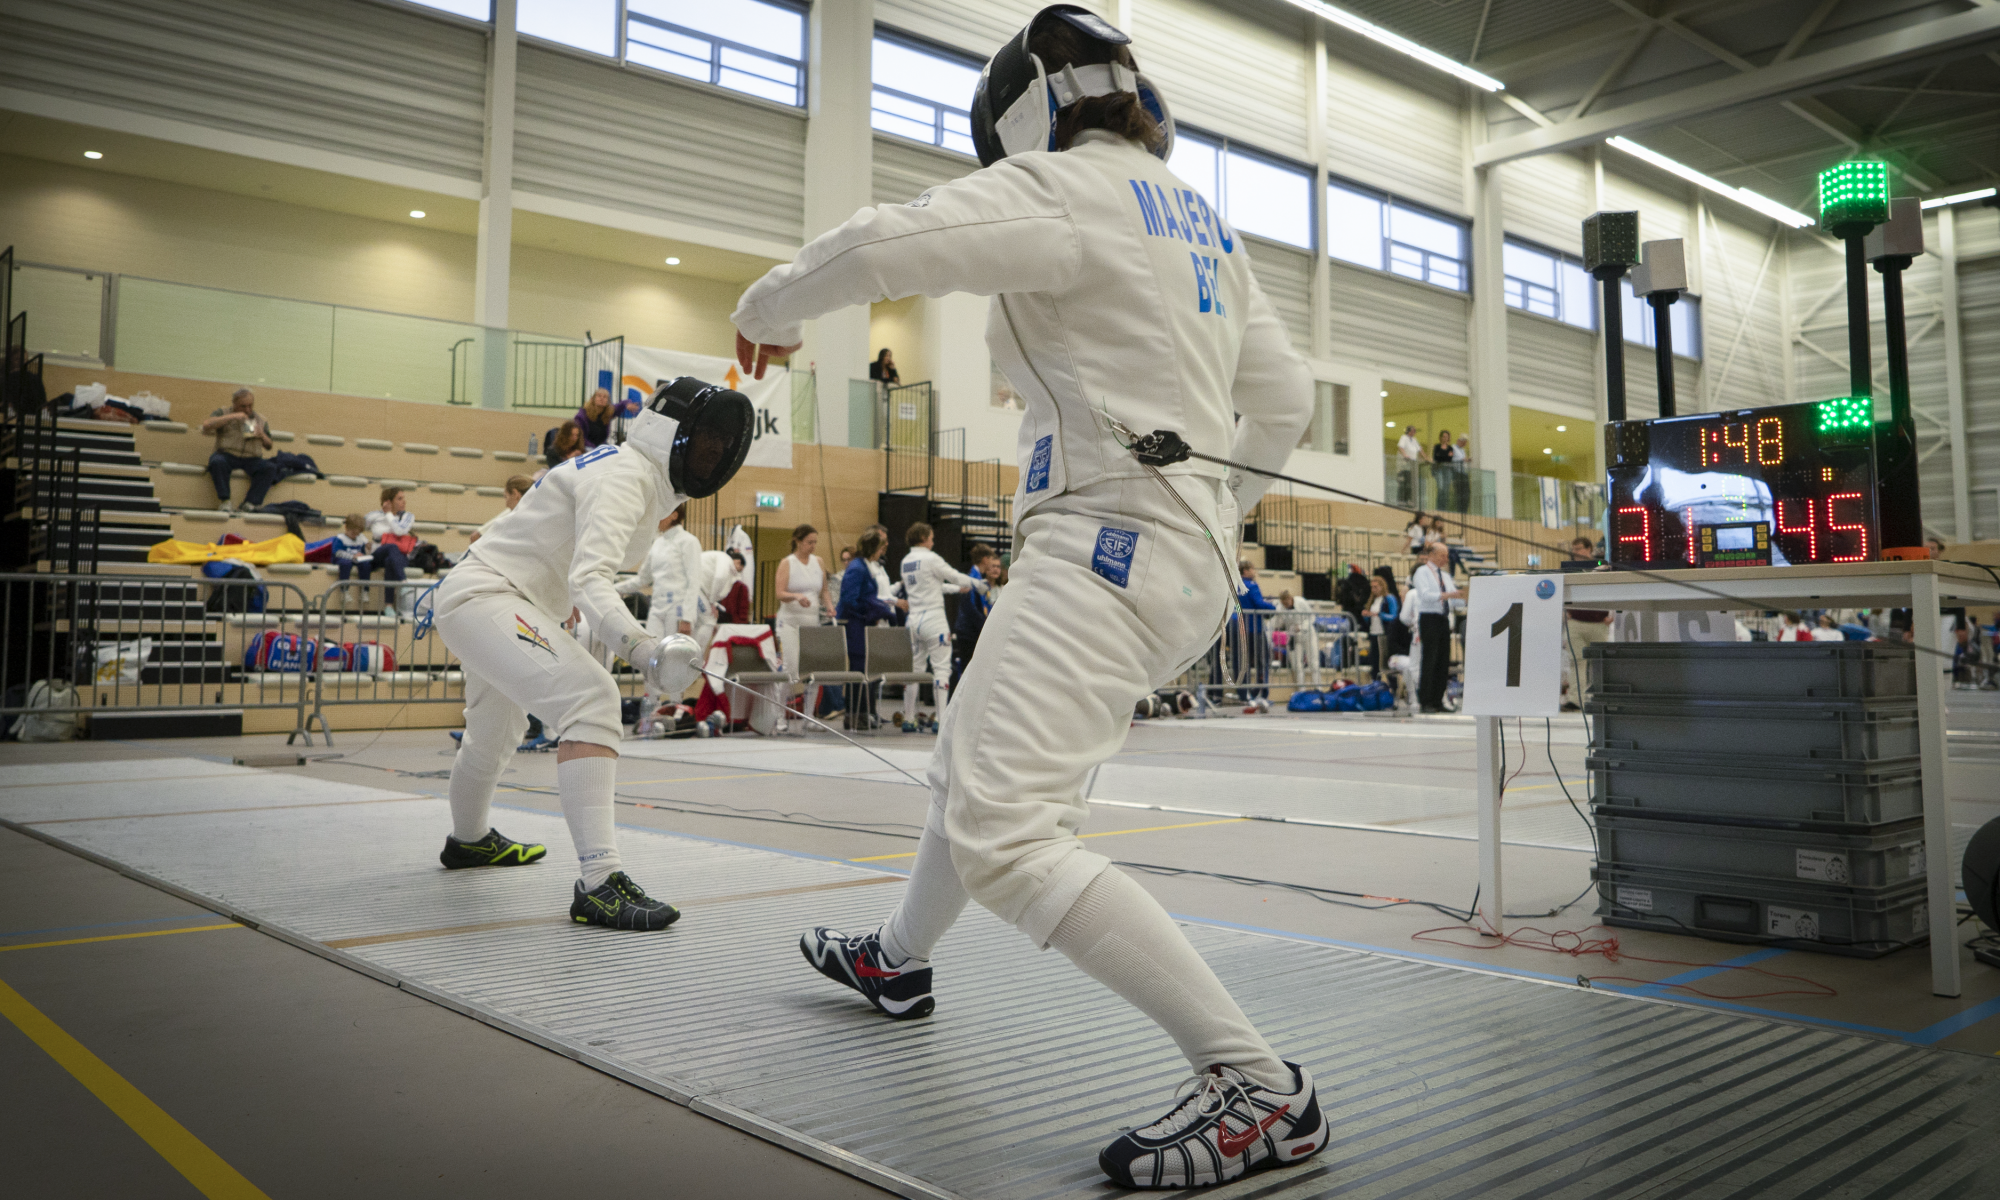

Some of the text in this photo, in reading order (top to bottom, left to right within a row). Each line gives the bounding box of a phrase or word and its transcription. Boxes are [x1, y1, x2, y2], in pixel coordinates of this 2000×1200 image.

[754, 408, 779, 440] jk
[1701, 417, 1783, 467] 1:48
[1721, 474, 1747, 522] 9
[1777, 492, 1868, 562] 45
[1096, 554, 1126, 568] uhlmann
[1491, 602, 1523, 687] 1
[1771, 920, 1779, 930] F
